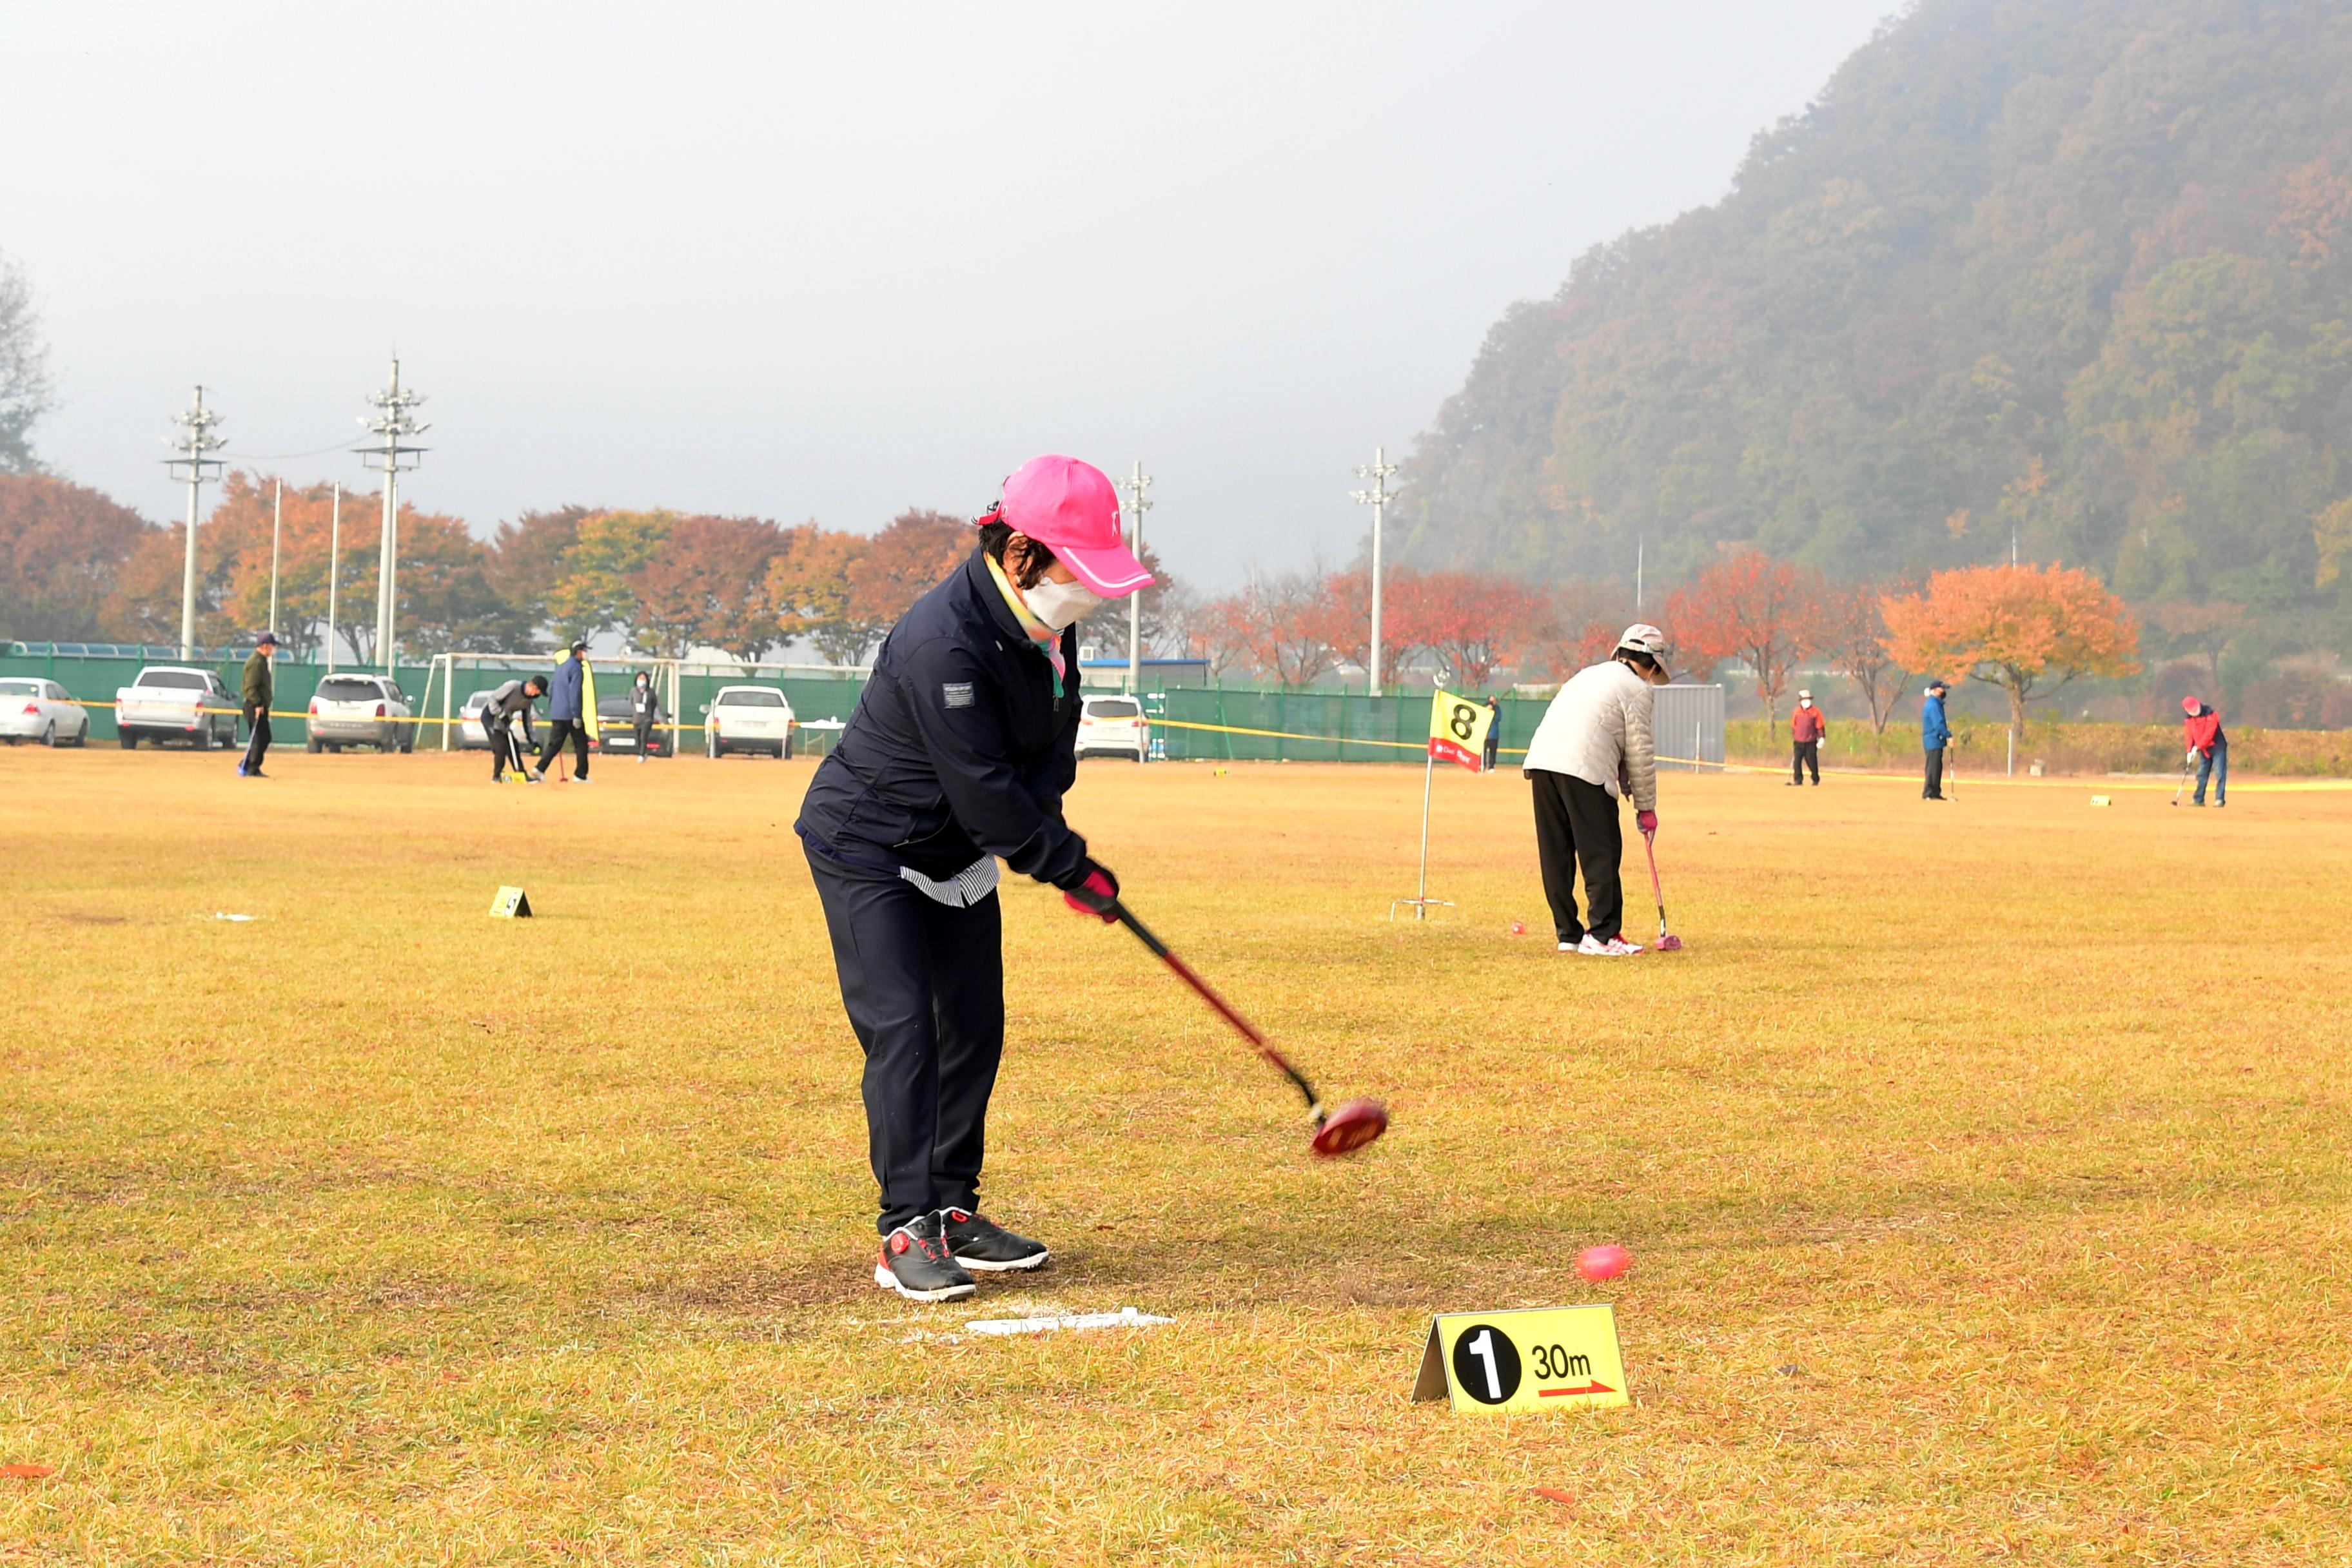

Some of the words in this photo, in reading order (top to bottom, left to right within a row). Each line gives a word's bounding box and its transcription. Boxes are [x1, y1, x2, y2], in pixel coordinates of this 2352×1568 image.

[1451, 704, 1476, 740] 8
[1469, 1329, 1502, 1398] 1
[1531, 1344, 1591, 1380] 30m
